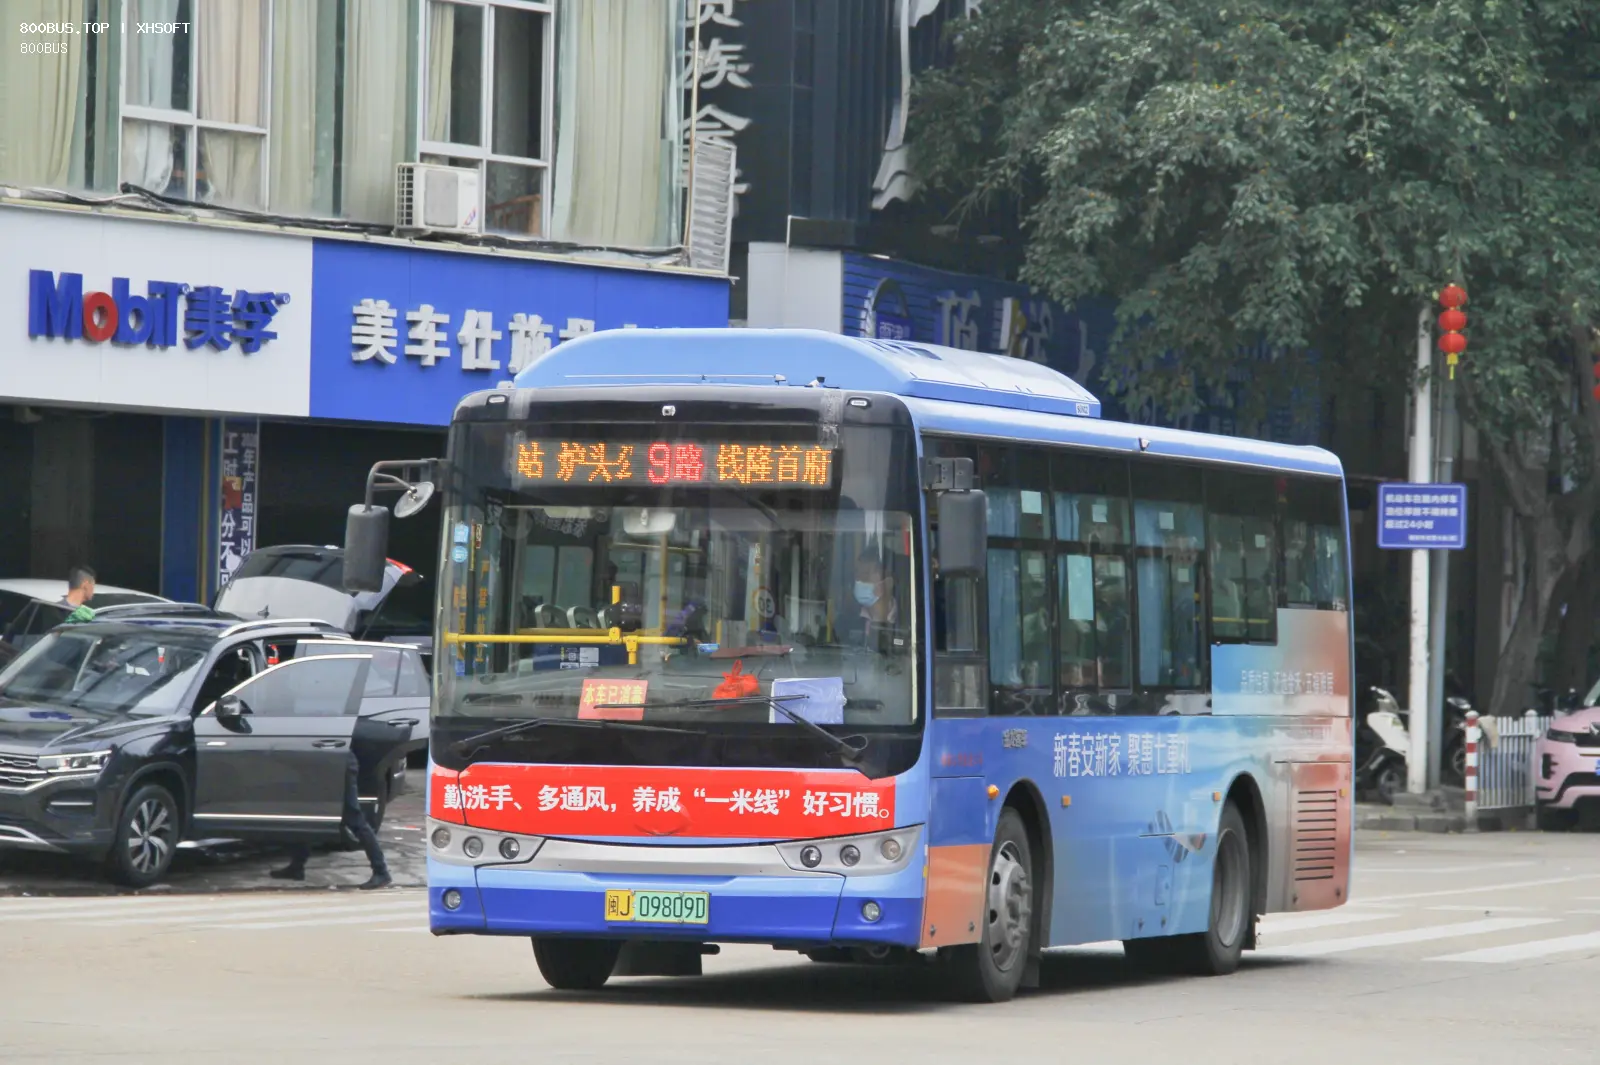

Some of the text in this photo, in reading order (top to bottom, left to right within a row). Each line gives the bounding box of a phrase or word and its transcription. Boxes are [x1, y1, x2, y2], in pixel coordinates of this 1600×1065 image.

[183, 285, 278, 353] 美孚
[647, 442, 704, 484] 9路
[717, 444, 832, 485] 钱隆首府
[584, 683, 643, 706] 本车已消毒
[1053, 732, 1122, 778] 新春安新家
